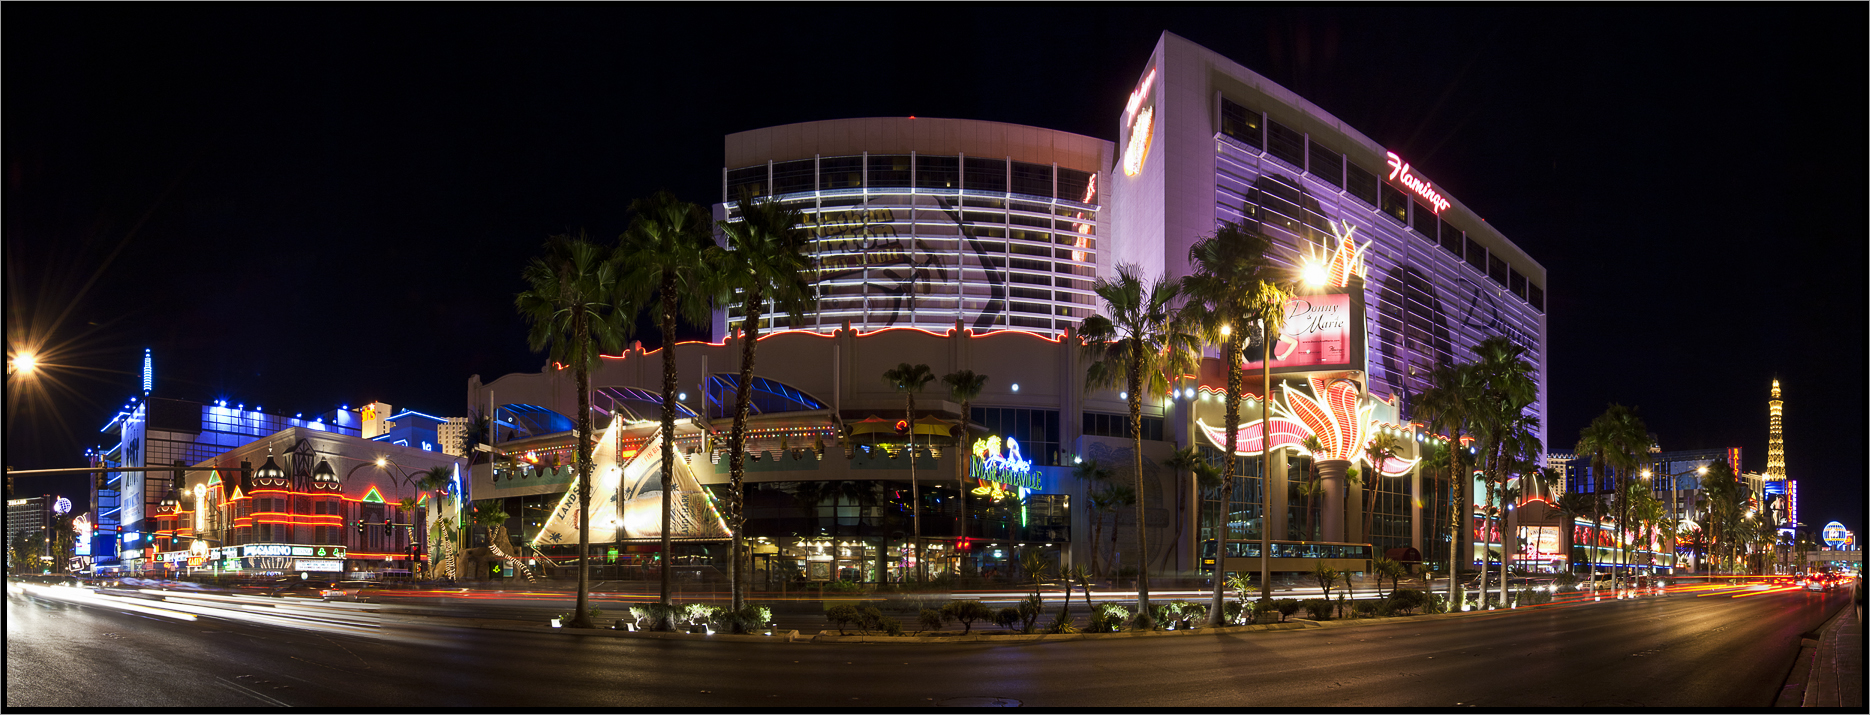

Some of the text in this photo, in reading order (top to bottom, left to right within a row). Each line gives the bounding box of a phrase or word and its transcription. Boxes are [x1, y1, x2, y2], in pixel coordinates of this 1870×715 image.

[1386, 151, 1451, 214] Flamingo
[805, 206, 895, 238] Nathan
[855, 247, 900, 267] MAGIC
[1286, 299, 1339, 319] Donny
[1456, 278, 1535, 357] Donny
[1287, 314, 1344, 336] Marie
[643, 451, 654, 462] FIN
[256, 545, 292, 556] CASINO
